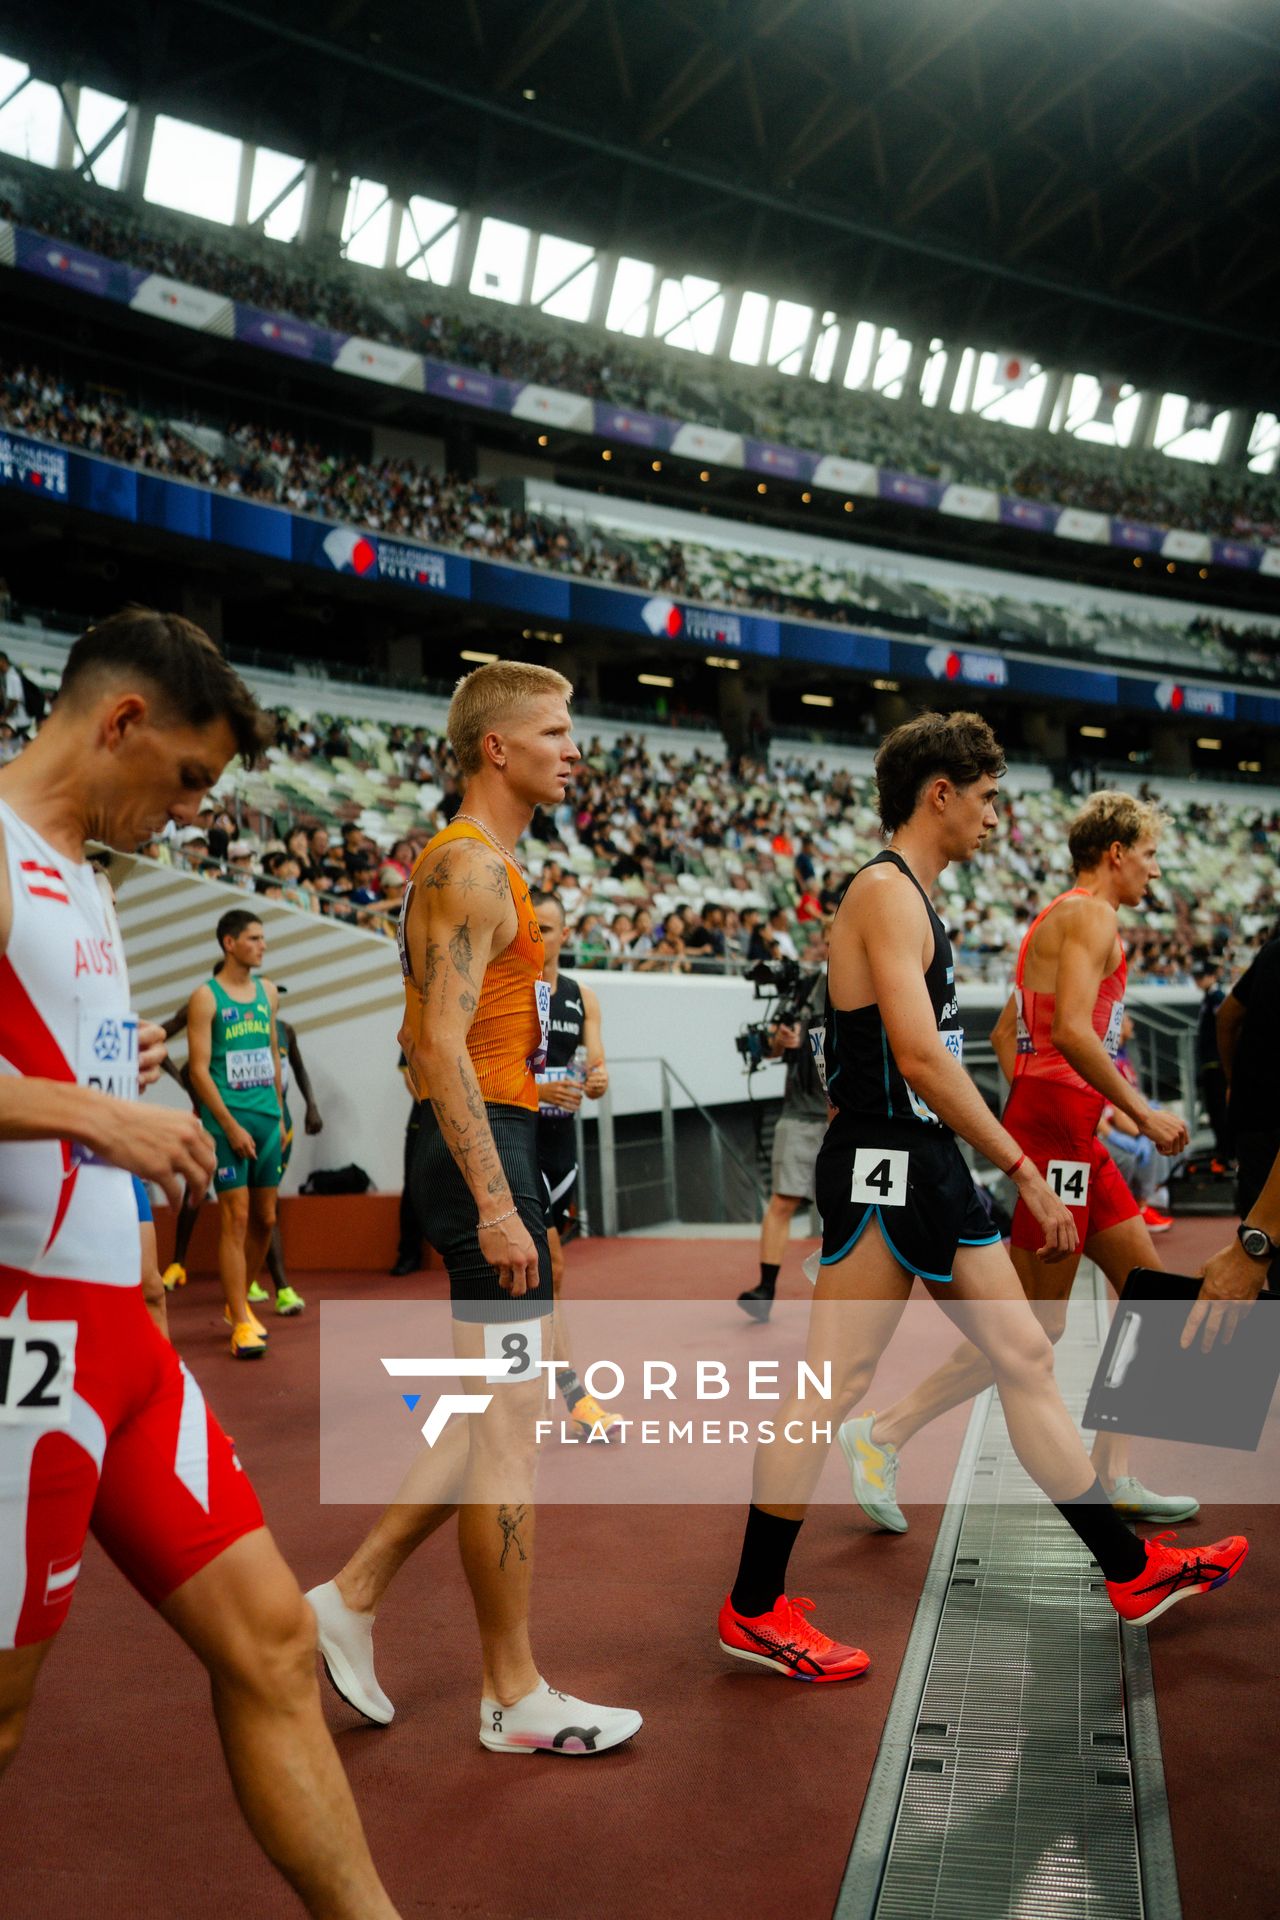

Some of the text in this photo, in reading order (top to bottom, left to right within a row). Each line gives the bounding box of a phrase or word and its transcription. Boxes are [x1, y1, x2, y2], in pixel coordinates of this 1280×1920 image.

[865, 1159, 894, 1197] 4
[1047, 1168, 1085, 1199] 14
[0, 1337, 61, 1407] 12
[501, 1333, 531, 1375] 8
